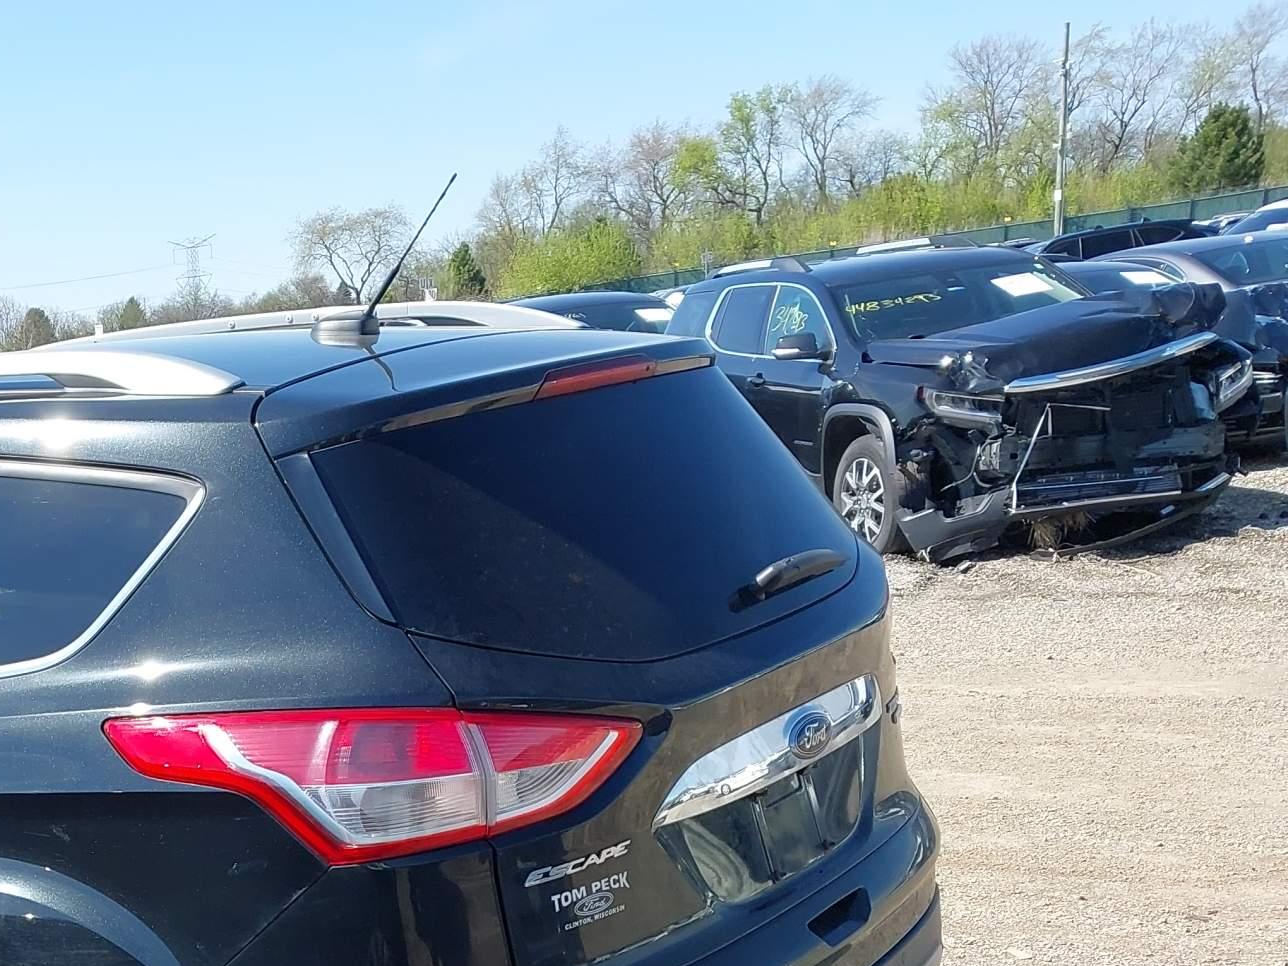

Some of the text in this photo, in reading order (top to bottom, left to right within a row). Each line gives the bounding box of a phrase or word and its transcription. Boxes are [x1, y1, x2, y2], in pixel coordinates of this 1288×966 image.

[798, 721, 827, 749] Ford
[524, 839, 631, 888] ESCAPE
[551, 871, 630, 913] TOM PECK
